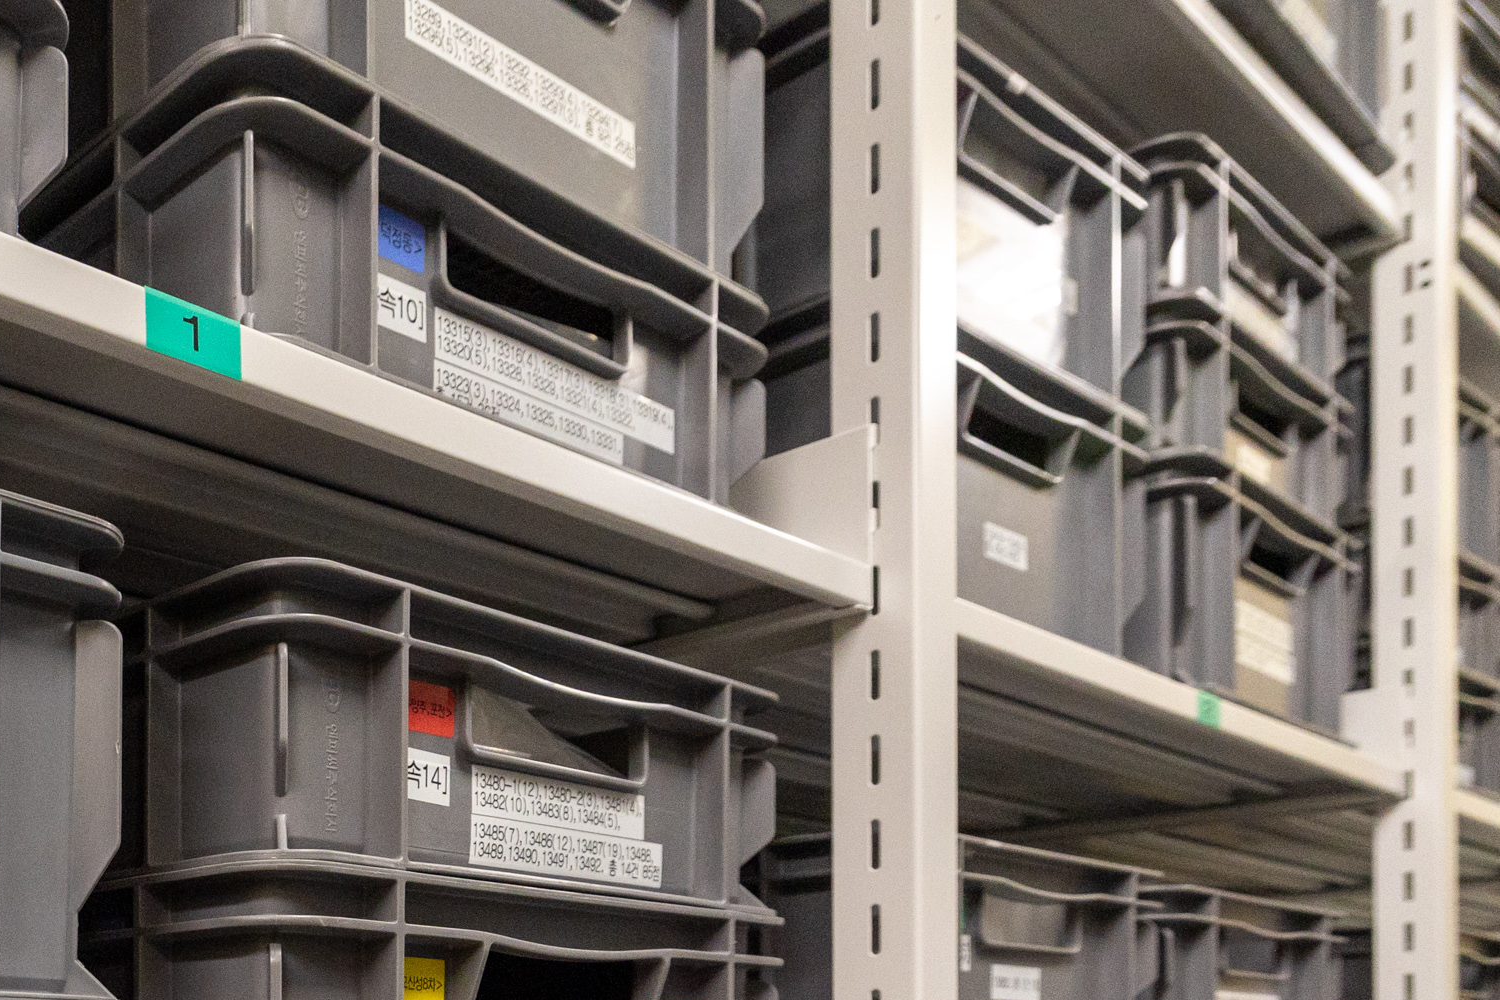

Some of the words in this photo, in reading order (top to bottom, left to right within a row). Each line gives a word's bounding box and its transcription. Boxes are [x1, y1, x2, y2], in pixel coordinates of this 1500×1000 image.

[378, 287, 424, 330] 속10]
[183, 315, 199, 352] 1
[409, 698, 452, 719] 양주,포천>
[609, 859, 617, 876] 총
[621, 862, 638, 880] 14건
